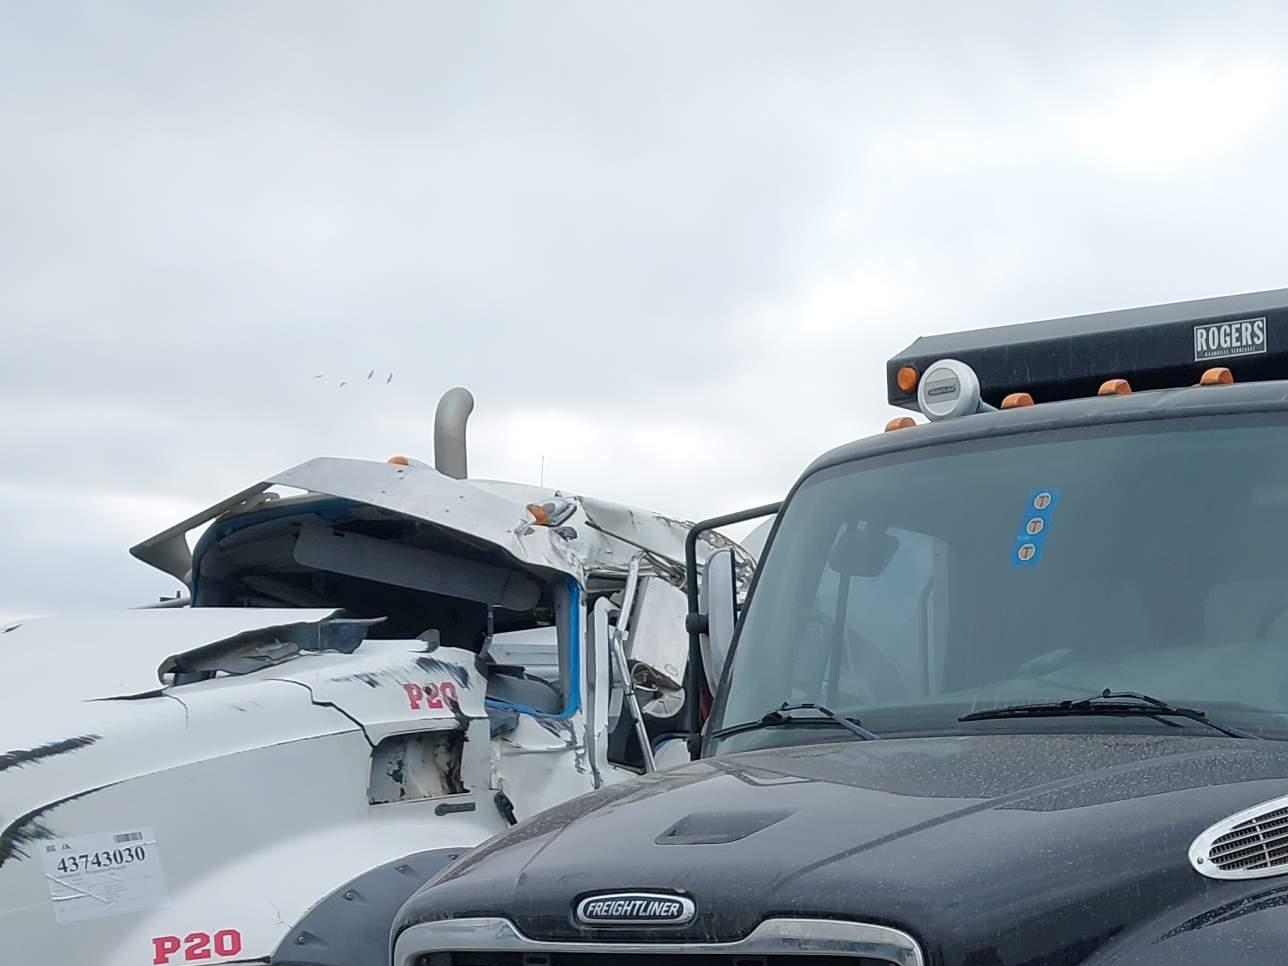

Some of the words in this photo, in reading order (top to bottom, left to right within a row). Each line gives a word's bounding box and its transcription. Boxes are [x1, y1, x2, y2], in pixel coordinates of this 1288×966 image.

[1197, 321, 1264, 352] ROGERS
[57, 845, 145, 873] 43743030
[586, 900, 680, 916] FREIGHTLINER
[152, 929, 241, 965] P20
